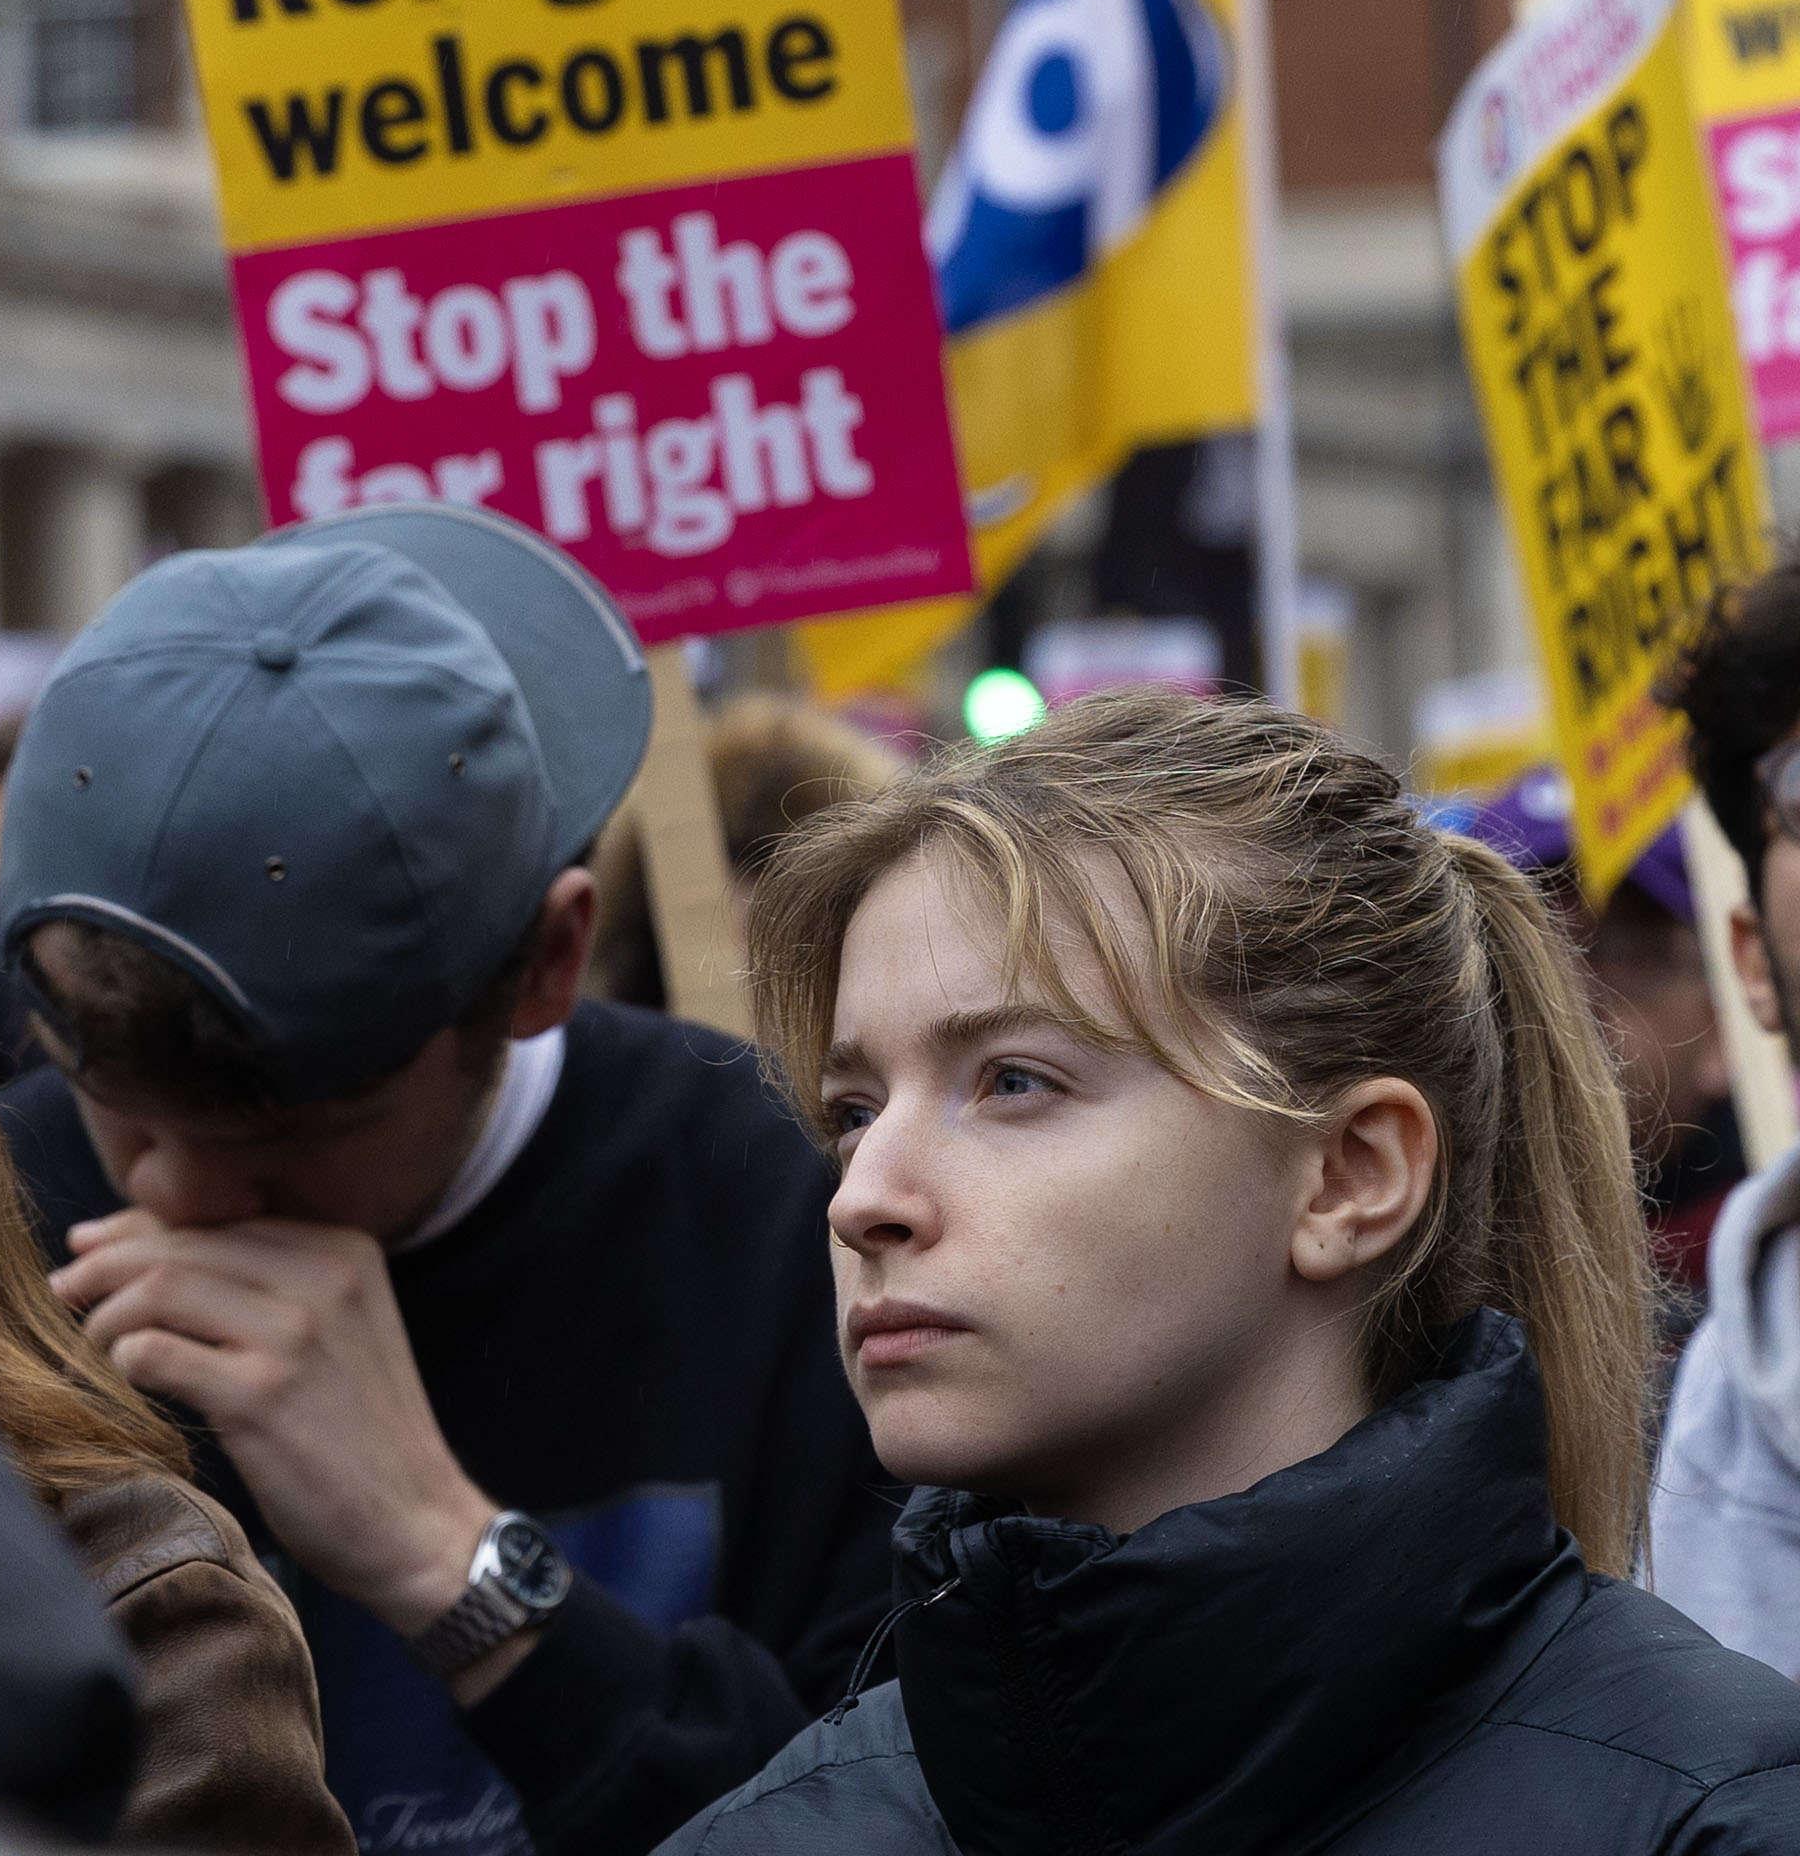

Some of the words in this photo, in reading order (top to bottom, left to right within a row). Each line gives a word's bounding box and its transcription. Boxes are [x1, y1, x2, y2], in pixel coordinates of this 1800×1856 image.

[241, 13, 842, 184] welcome
[266, 265, 600, 418] Stop
[615, 210, 858, 361] the
[1484, 97, 1650, 337] STOP
[534, 364, 877, 558] right
